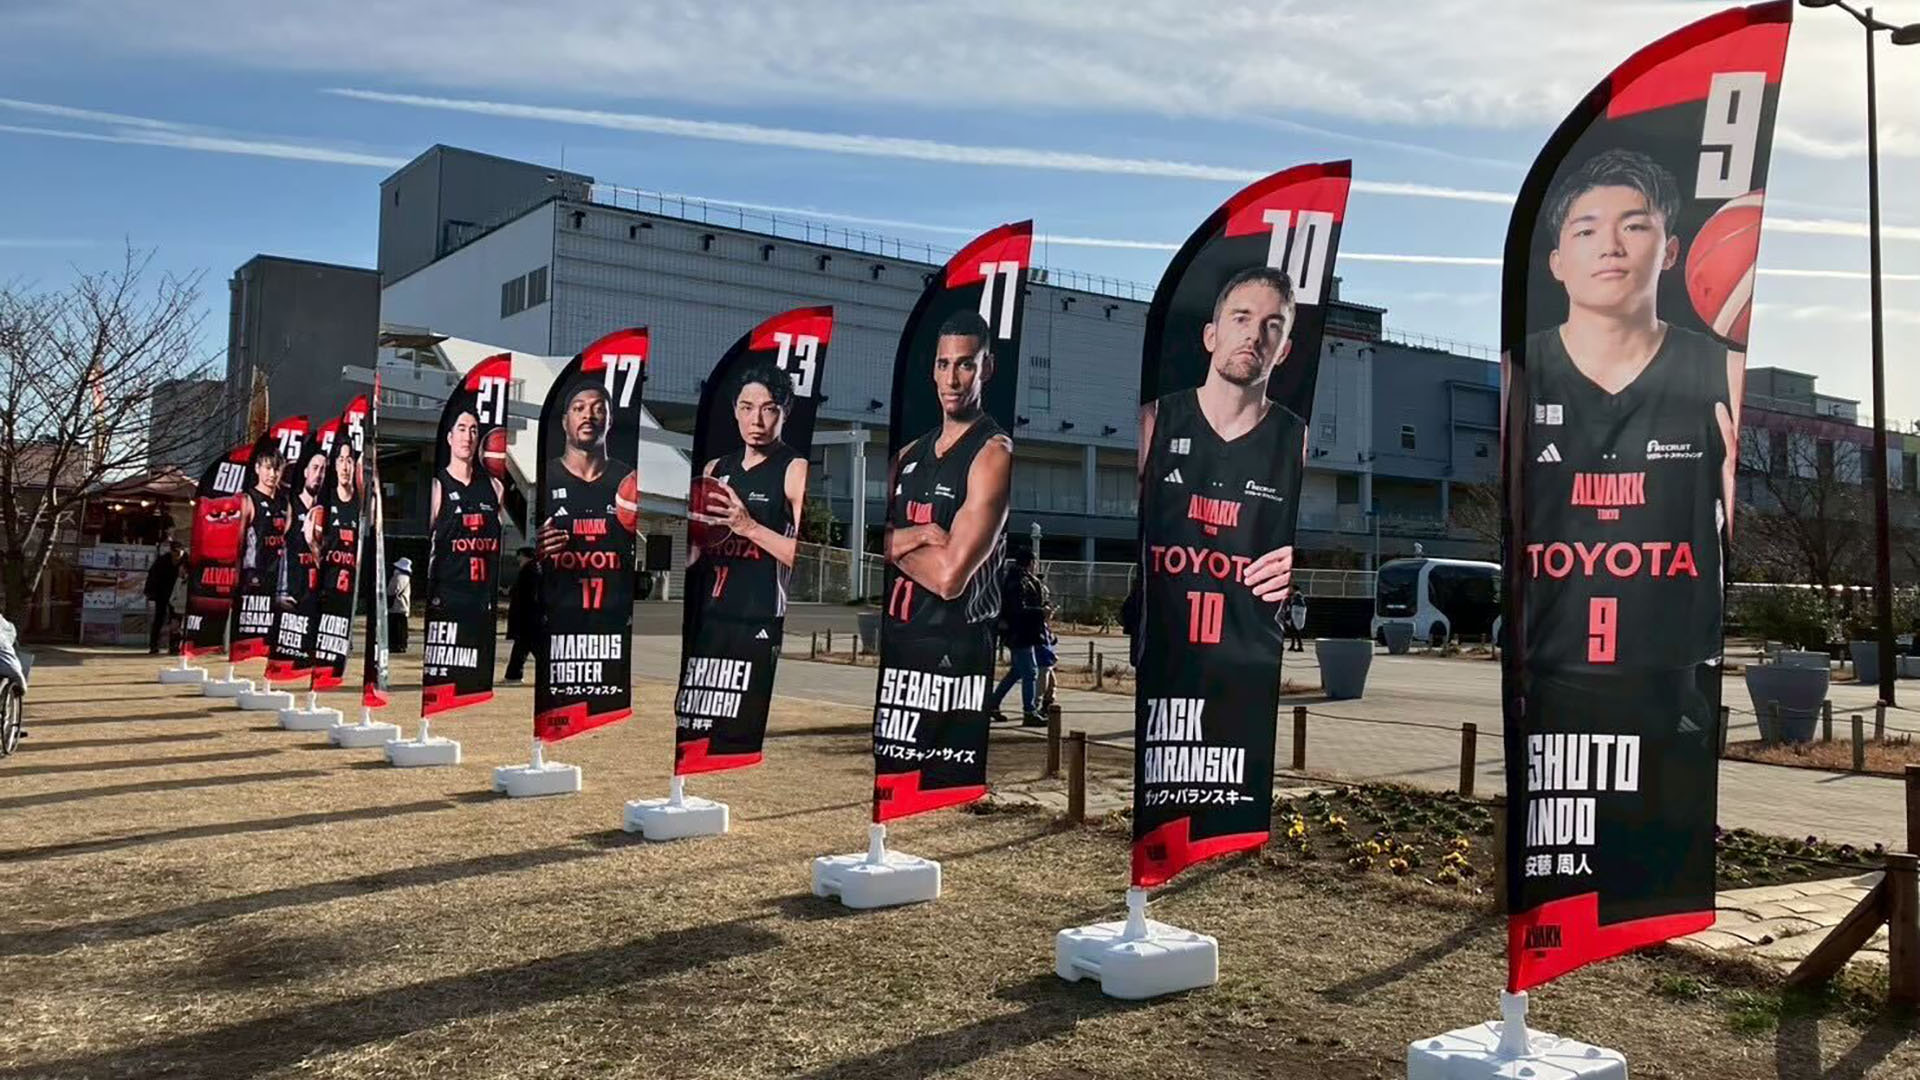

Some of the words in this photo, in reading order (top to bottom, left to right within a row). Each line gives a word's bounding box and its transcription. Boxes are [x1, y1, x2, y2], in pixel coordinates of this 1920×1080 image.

[1695, 71, 1767, 198] 9
[1263, 209, 1334, 305] 10
[979, 261, 1019, 339] 11
[602, 354, 642, 407] 17
[773, 332, 819, 398] 13
[476, 376, 506, 425] 21
[277, 428, 303, 460] 75
[1571, 472, 1645, 505] ALVARK
[1187, 494, 1241, 527] ALVARK
[551, 551, 621, 568] TOYOT
[1151, 545, 1251, 583] TOYOT
[1527, 541, 1698, 578] TOYOTA
[242, 595, 271, 612] TAIKI
[580, 578, 604, 609] 17
[427, 622, 457, 645] GEN
[1187, 591, 1224, 643] 10
[1588, 597, 1617, 662] 9
[551, 634, 622, 659] MARCUS
[550, 662, 602, 684] FOSTER
[683, 657, 752, 691] SHOHEI
[880, 667, 986, 712] SEBASTIAN
[1146, 698, 1205, 742] ZACK
[1145, 747, 1245, 785] BARANSKI
[1528, 734, 1640, 791] SHUTO
[1526, 798, 1596, 847] ANDO
[1556, 853, 1593, 876] 周人
